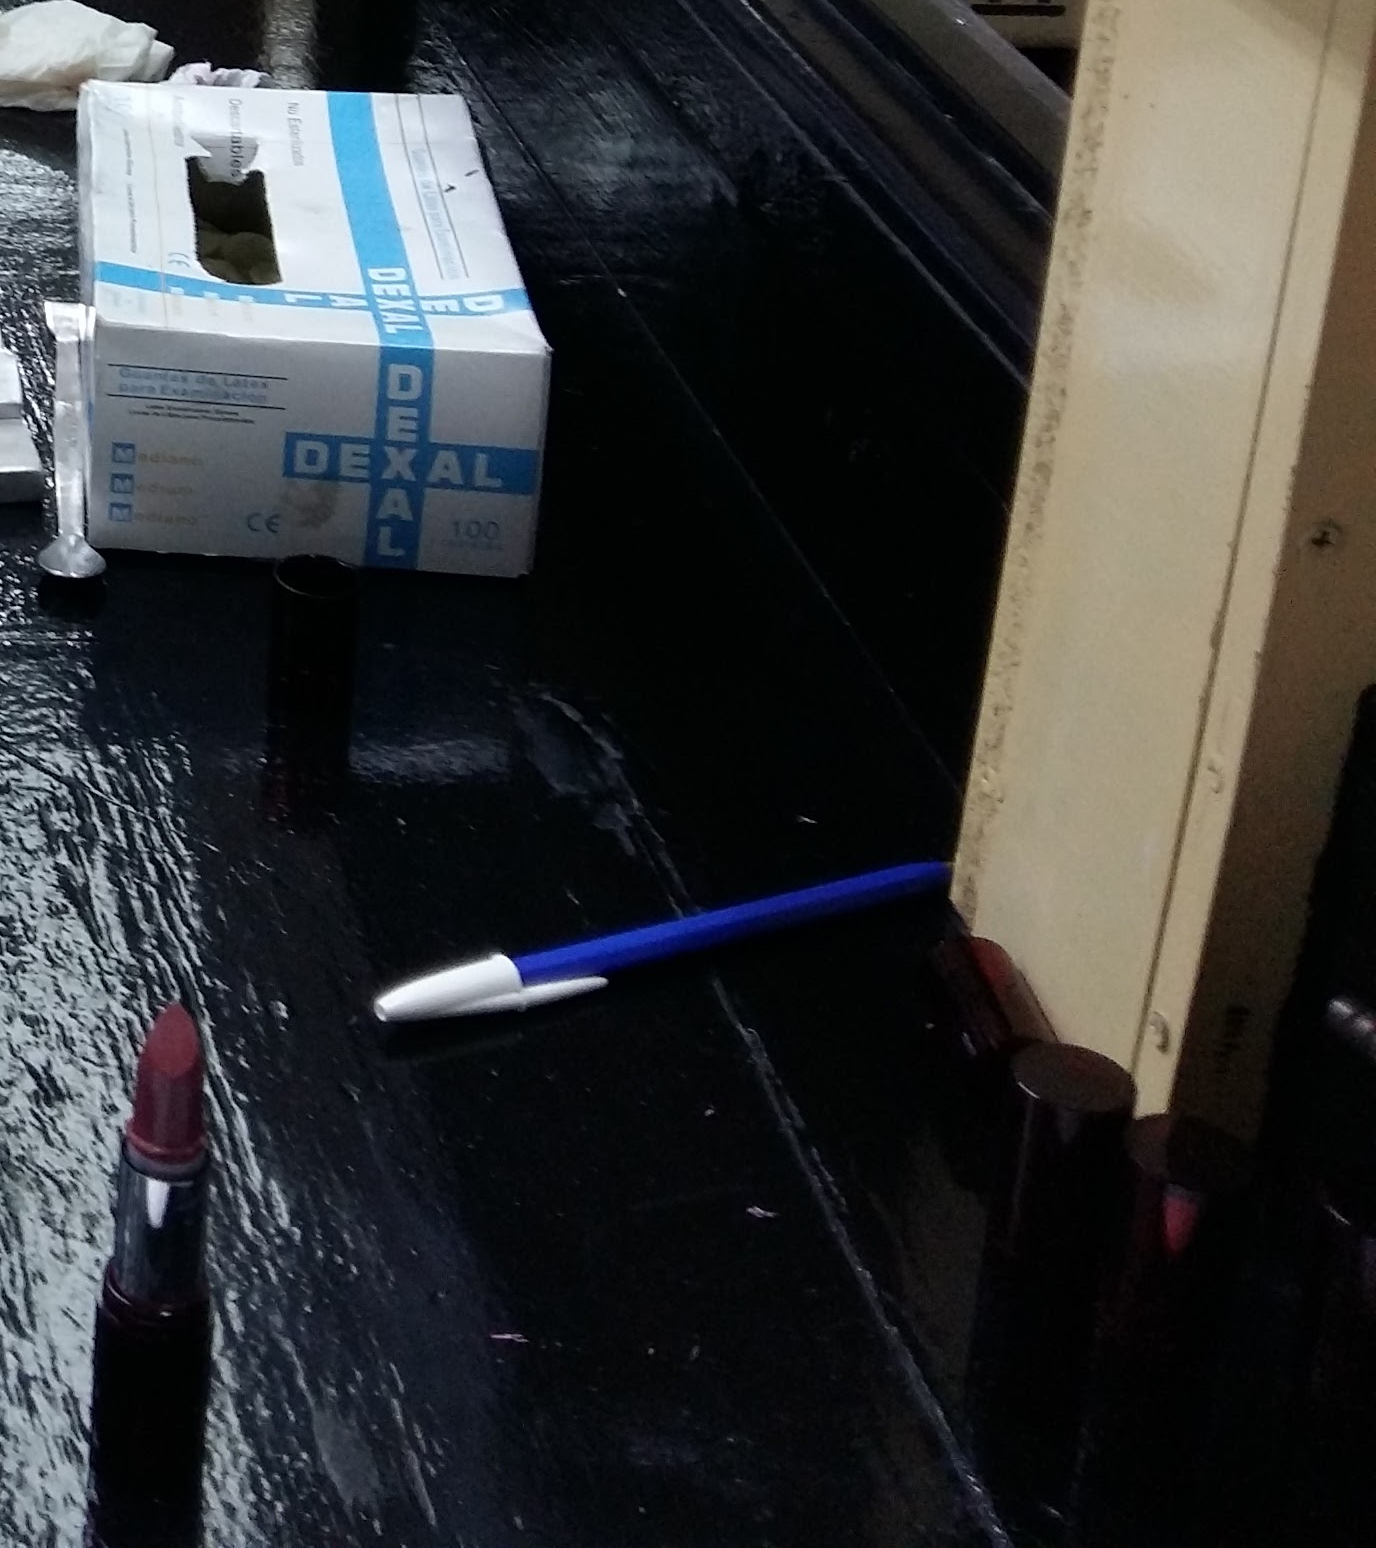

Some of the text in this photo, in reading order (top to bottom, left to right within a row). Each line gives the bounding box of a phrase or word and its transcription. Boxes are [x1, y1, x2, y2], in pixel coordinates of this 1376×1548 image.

[368, 267, 423, 335] DEXAL
[293, 440, 503, 488] DEXAL
[377, 363, 423, 558] DEXAL
[452, 520, 500, 540] 100
